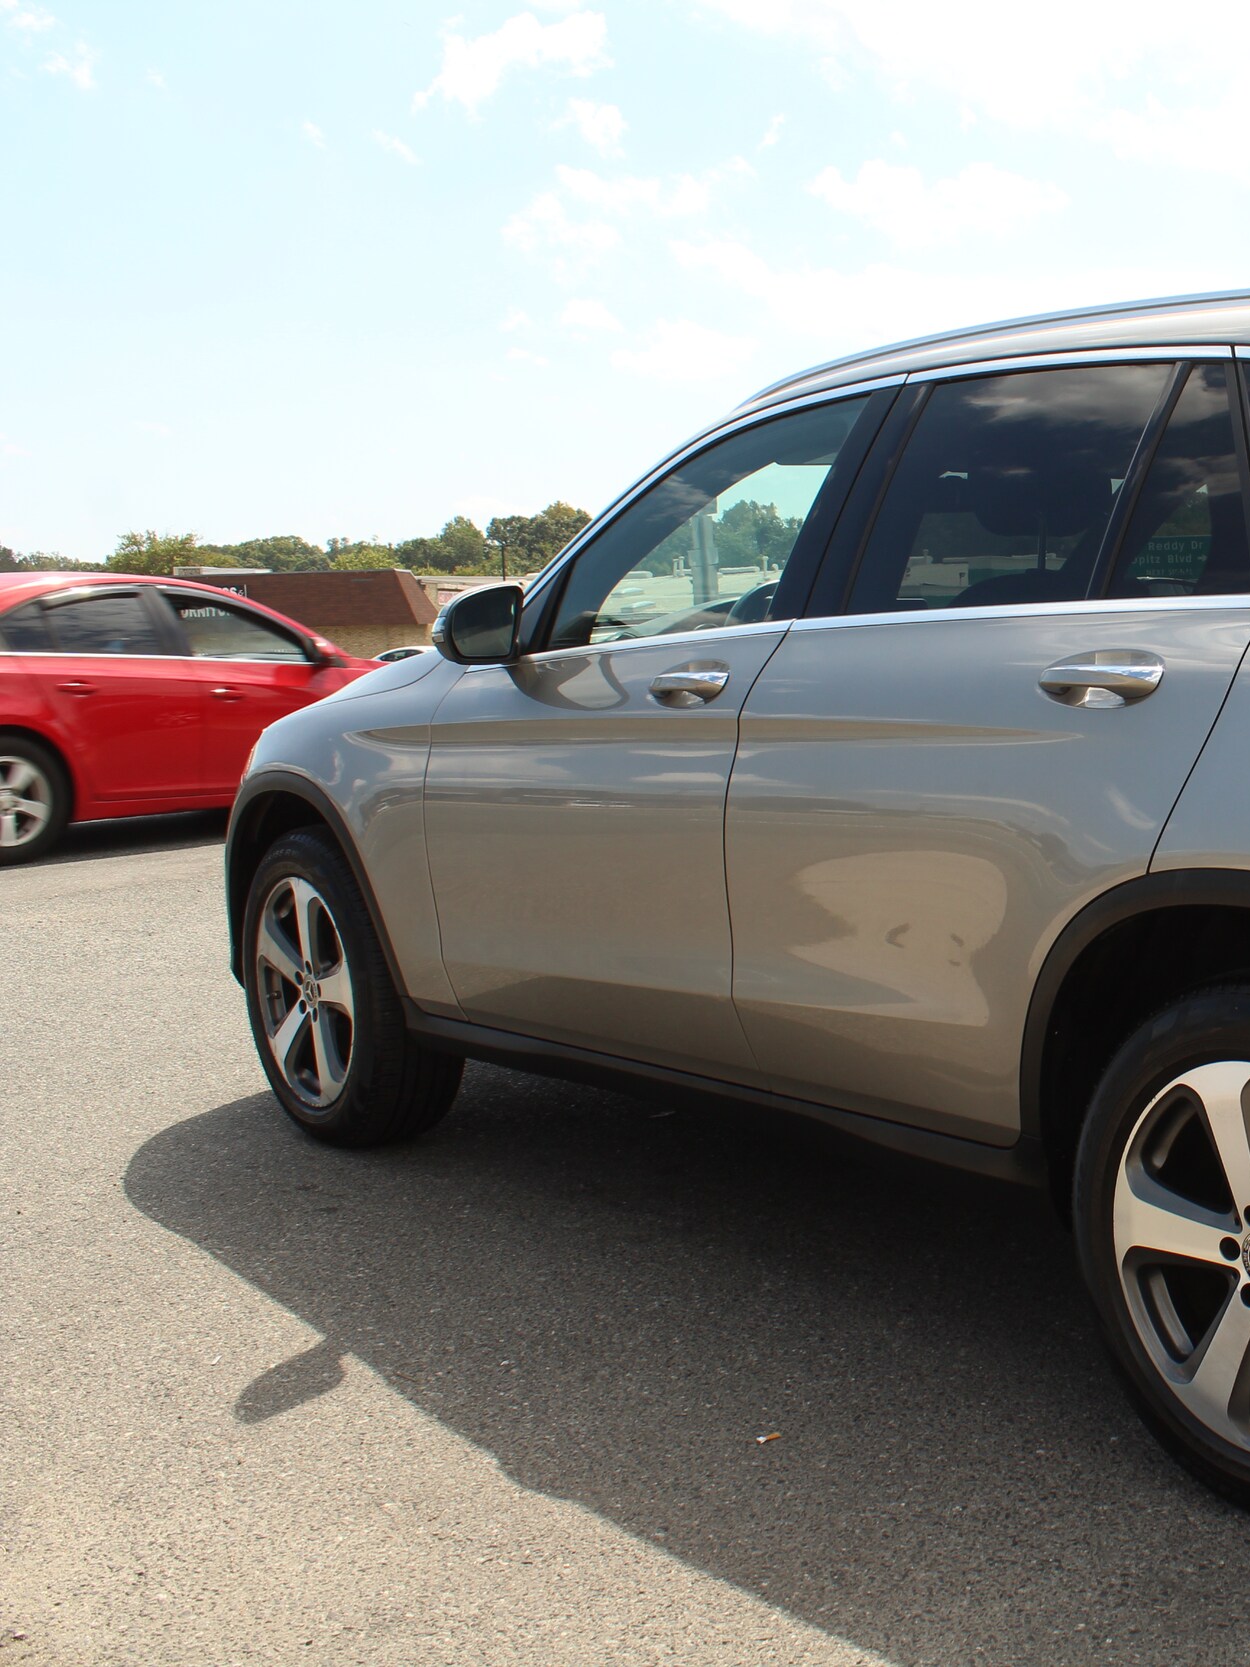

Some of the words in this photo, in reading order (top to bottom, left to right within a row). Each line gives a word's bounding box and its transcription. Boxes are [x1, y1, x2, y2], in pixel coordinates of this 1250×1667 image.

[1148, 541, 1185, 552] Reddy
[1191, 540, 1203, 550] Dr
[1168, 554, 1192, 563] Blvd
